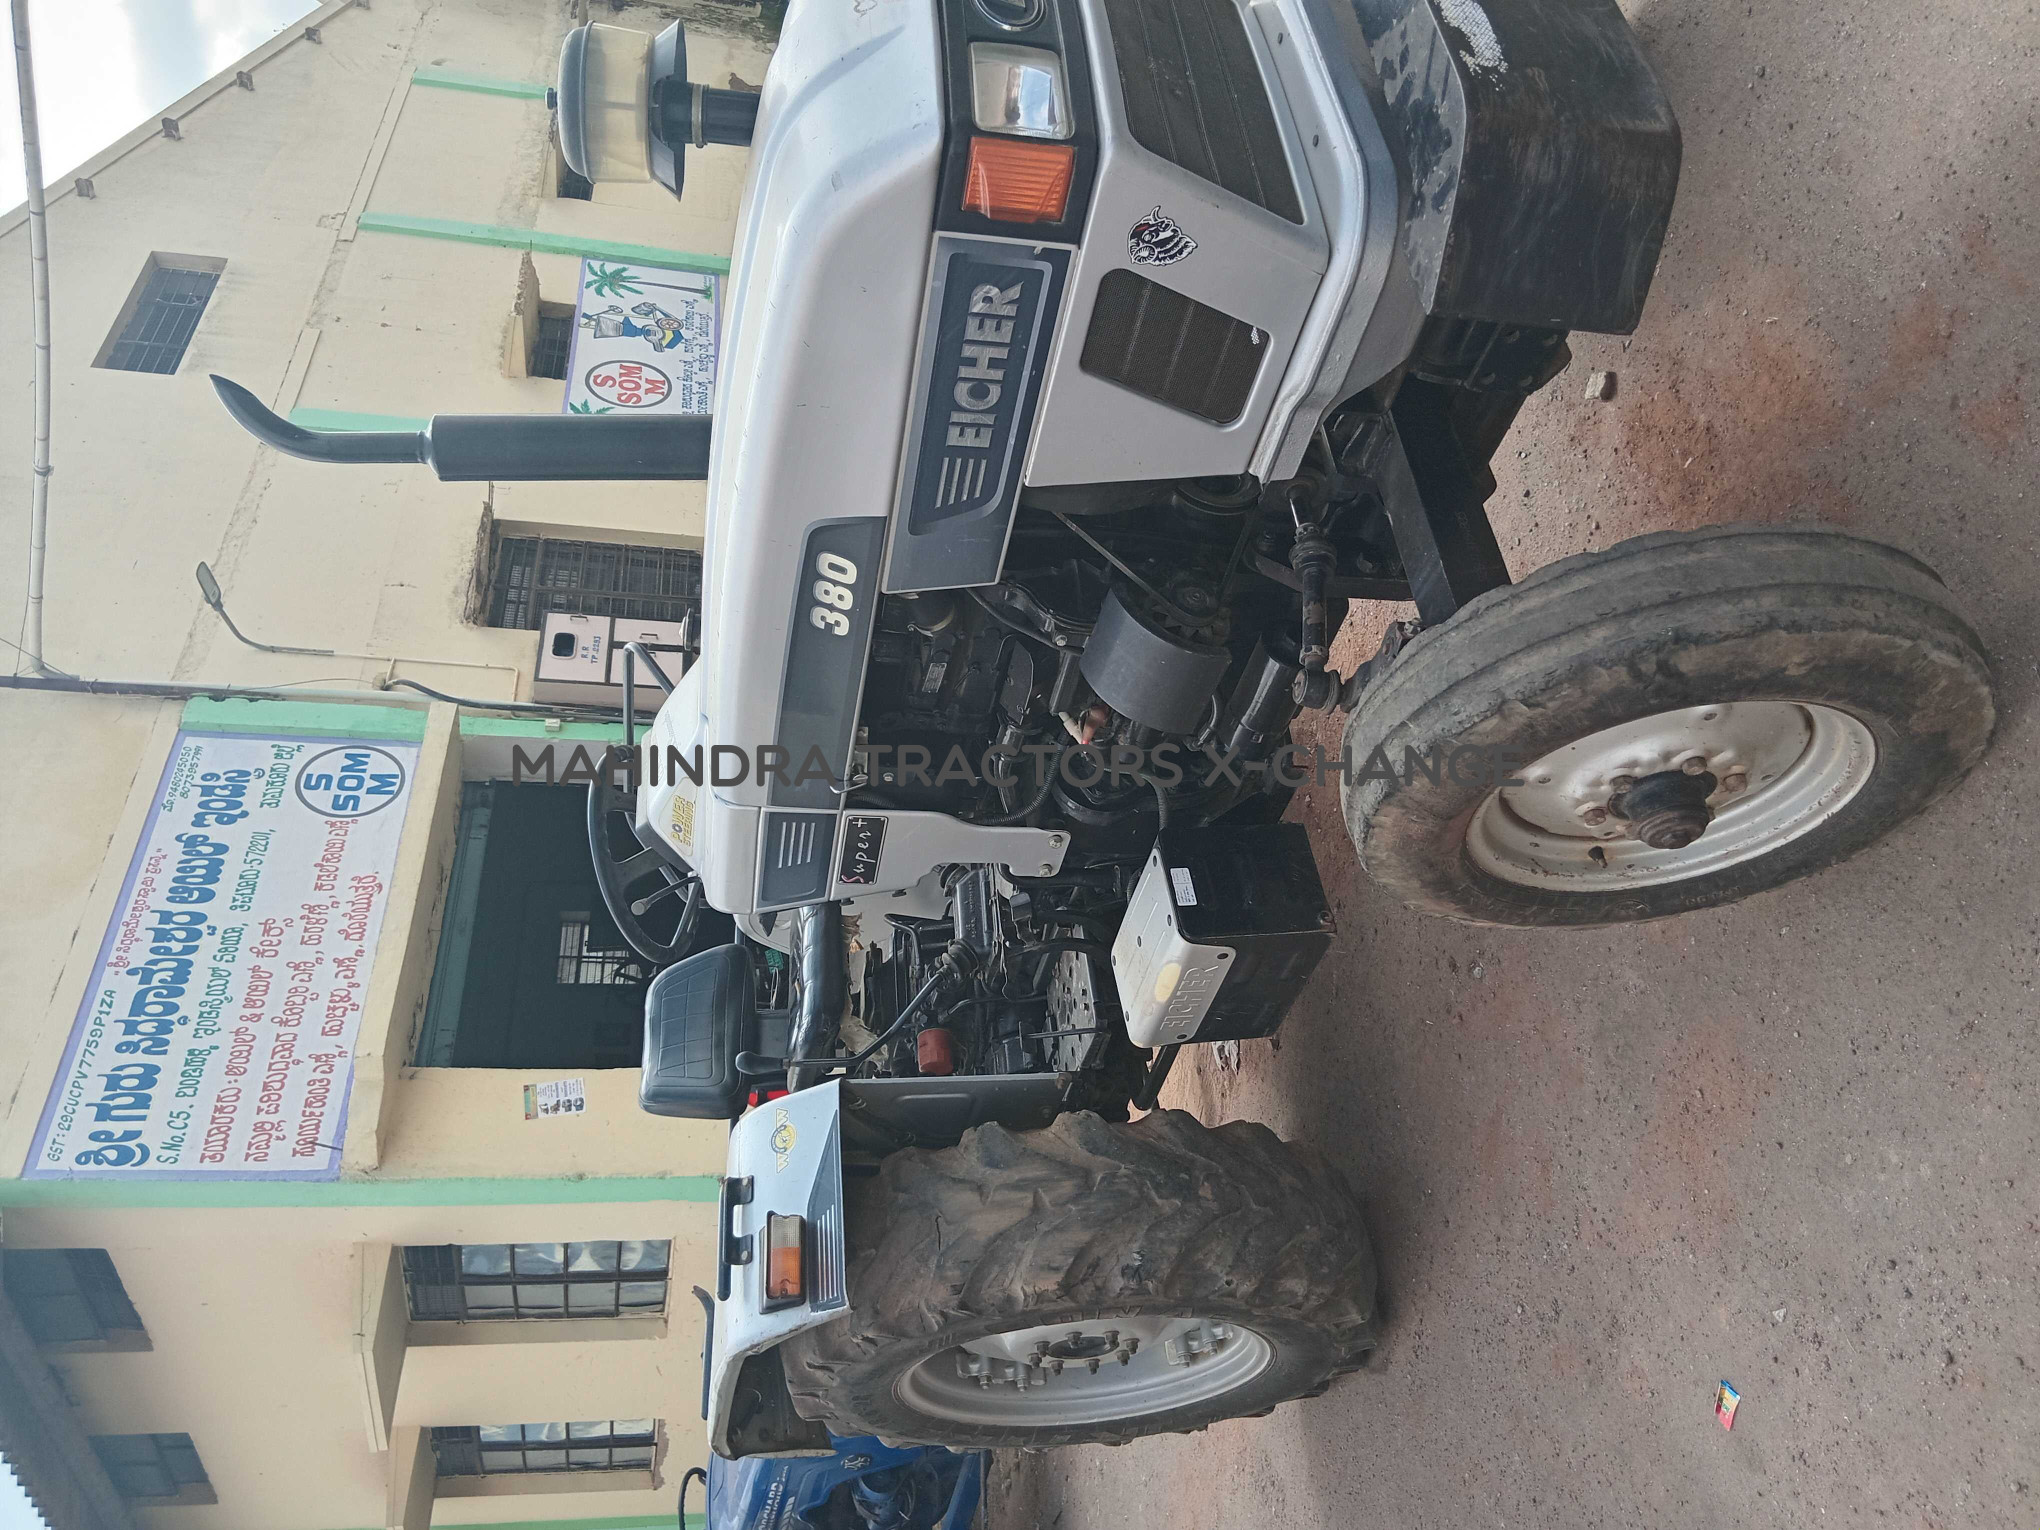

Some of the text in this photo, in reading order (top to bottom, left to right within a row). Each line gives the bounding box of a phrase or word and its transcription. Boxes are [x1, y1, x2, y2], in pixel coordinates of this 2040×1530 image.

[944, 280, 1026, 449] EICHER
[810, 551, 858, 636] 380
[670, 795, 686, 843] POWER
[682, 800, 694, 847] STEERING
[165, 832, 230, 904] ಆಯಿಲ್
[238, 1012, 264, 1023] &
[1159, 964, 1219, 1031] EICHER
[84, 1063, 162, 1122] ಗುರು
[74, 1129, 151, 1167] ಶ್ರೀ
